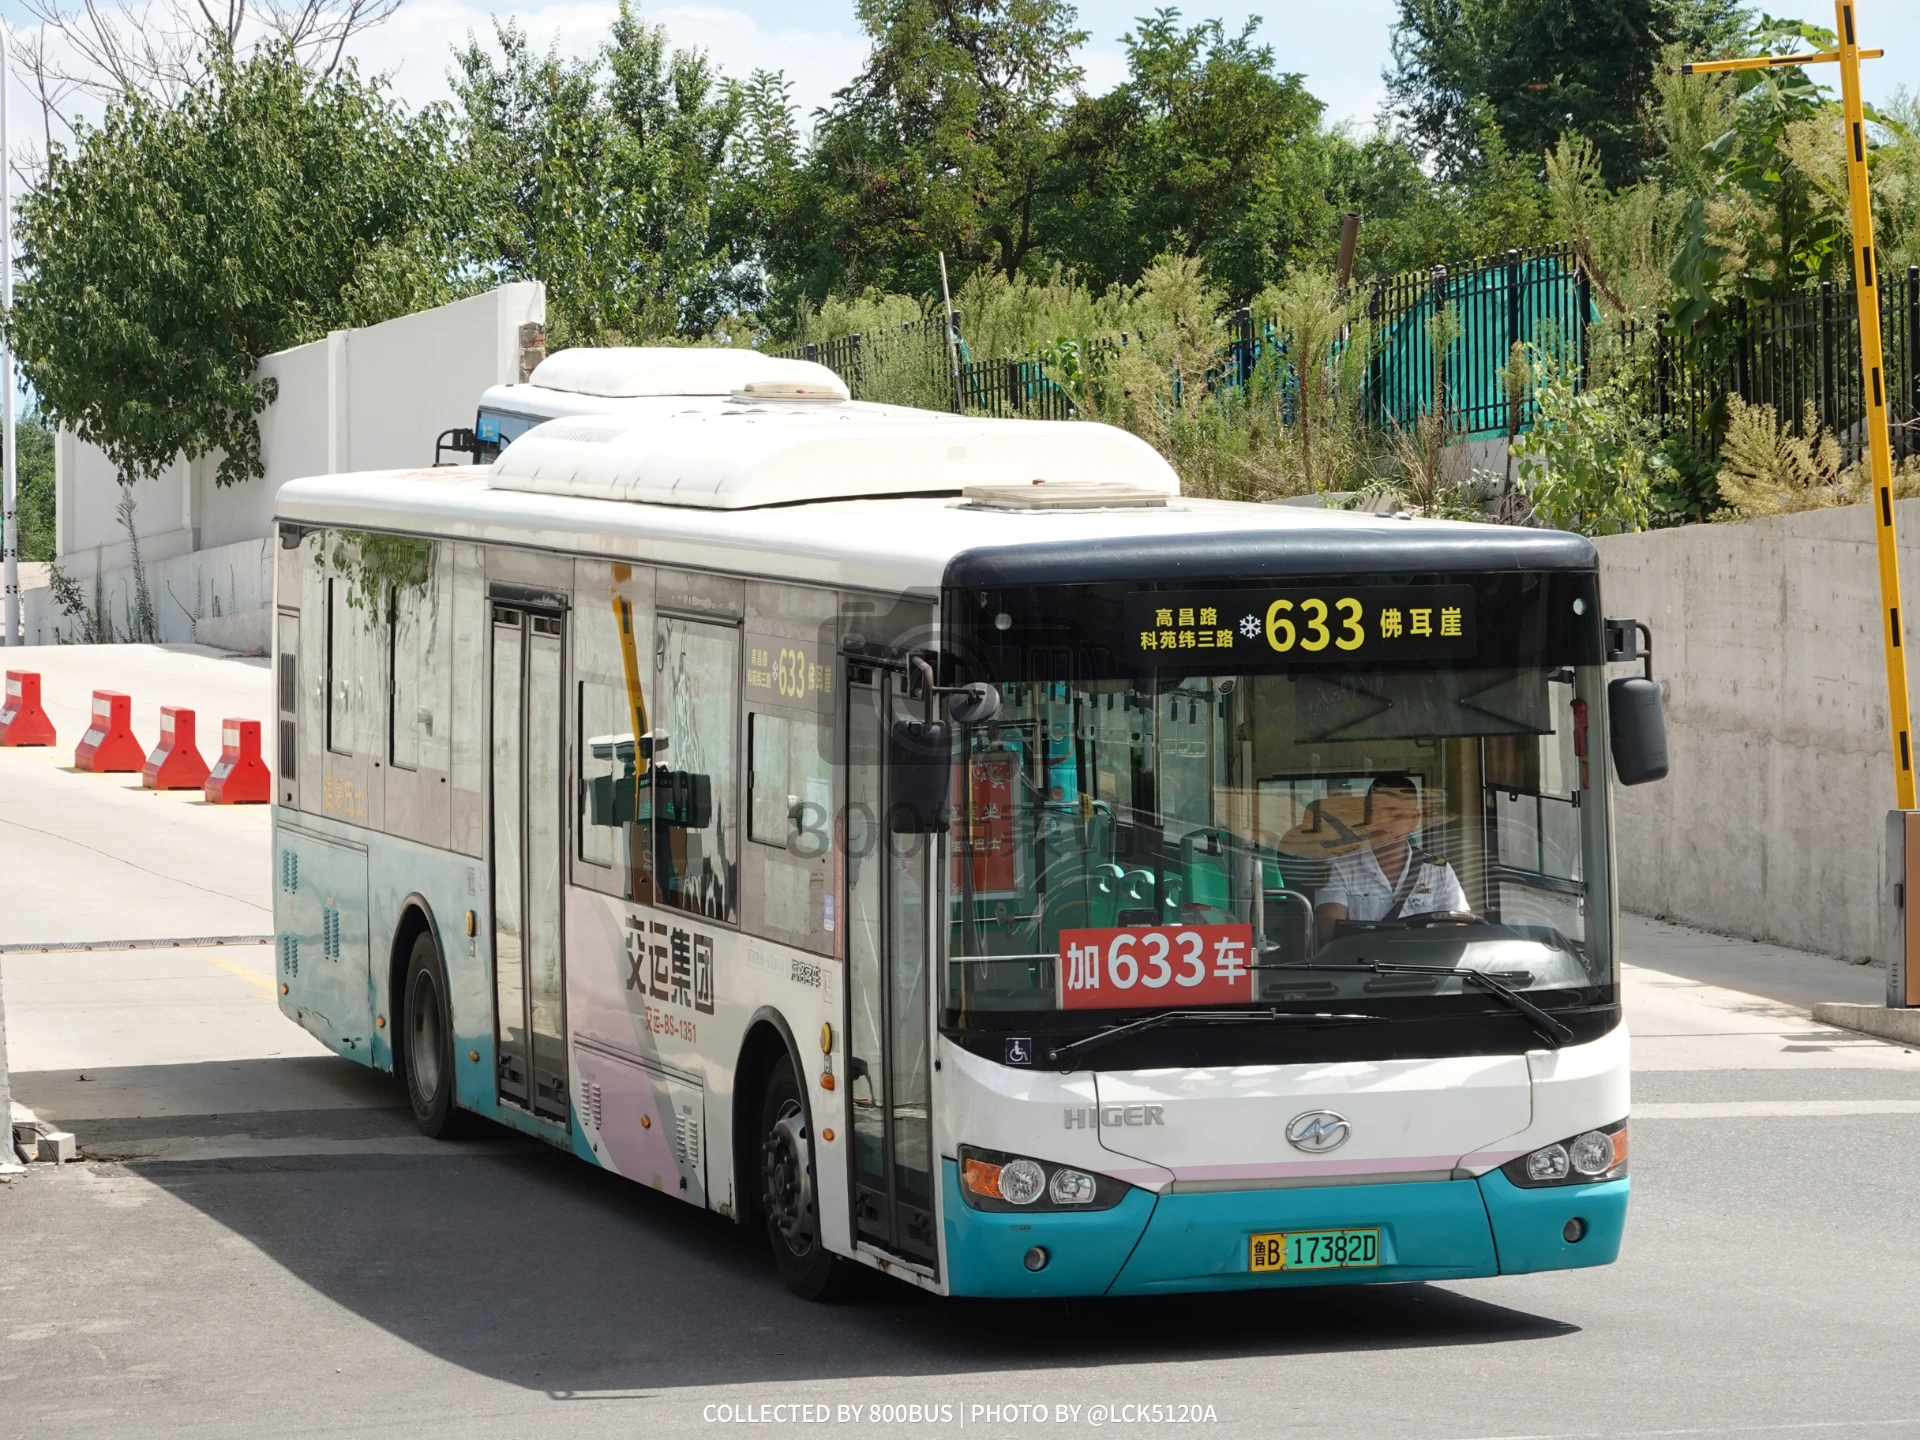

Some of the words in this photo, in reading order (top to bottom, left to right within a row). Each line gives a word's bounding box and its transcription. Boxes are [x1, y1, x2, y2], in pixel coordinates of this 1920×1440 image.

[1155, 607, 1218, 627] 高昌路
[1265, 597, 1365, 652] 633
[1380, 607, 1462, 638] 佛耳崖
[1140, 629, 1234, 650] 科苑纬三路
[779, 647, 805, 698] 633
[625, 914, 715, 1016] 交运集团
[1063, 1104, 1164, 1129] HIGER
